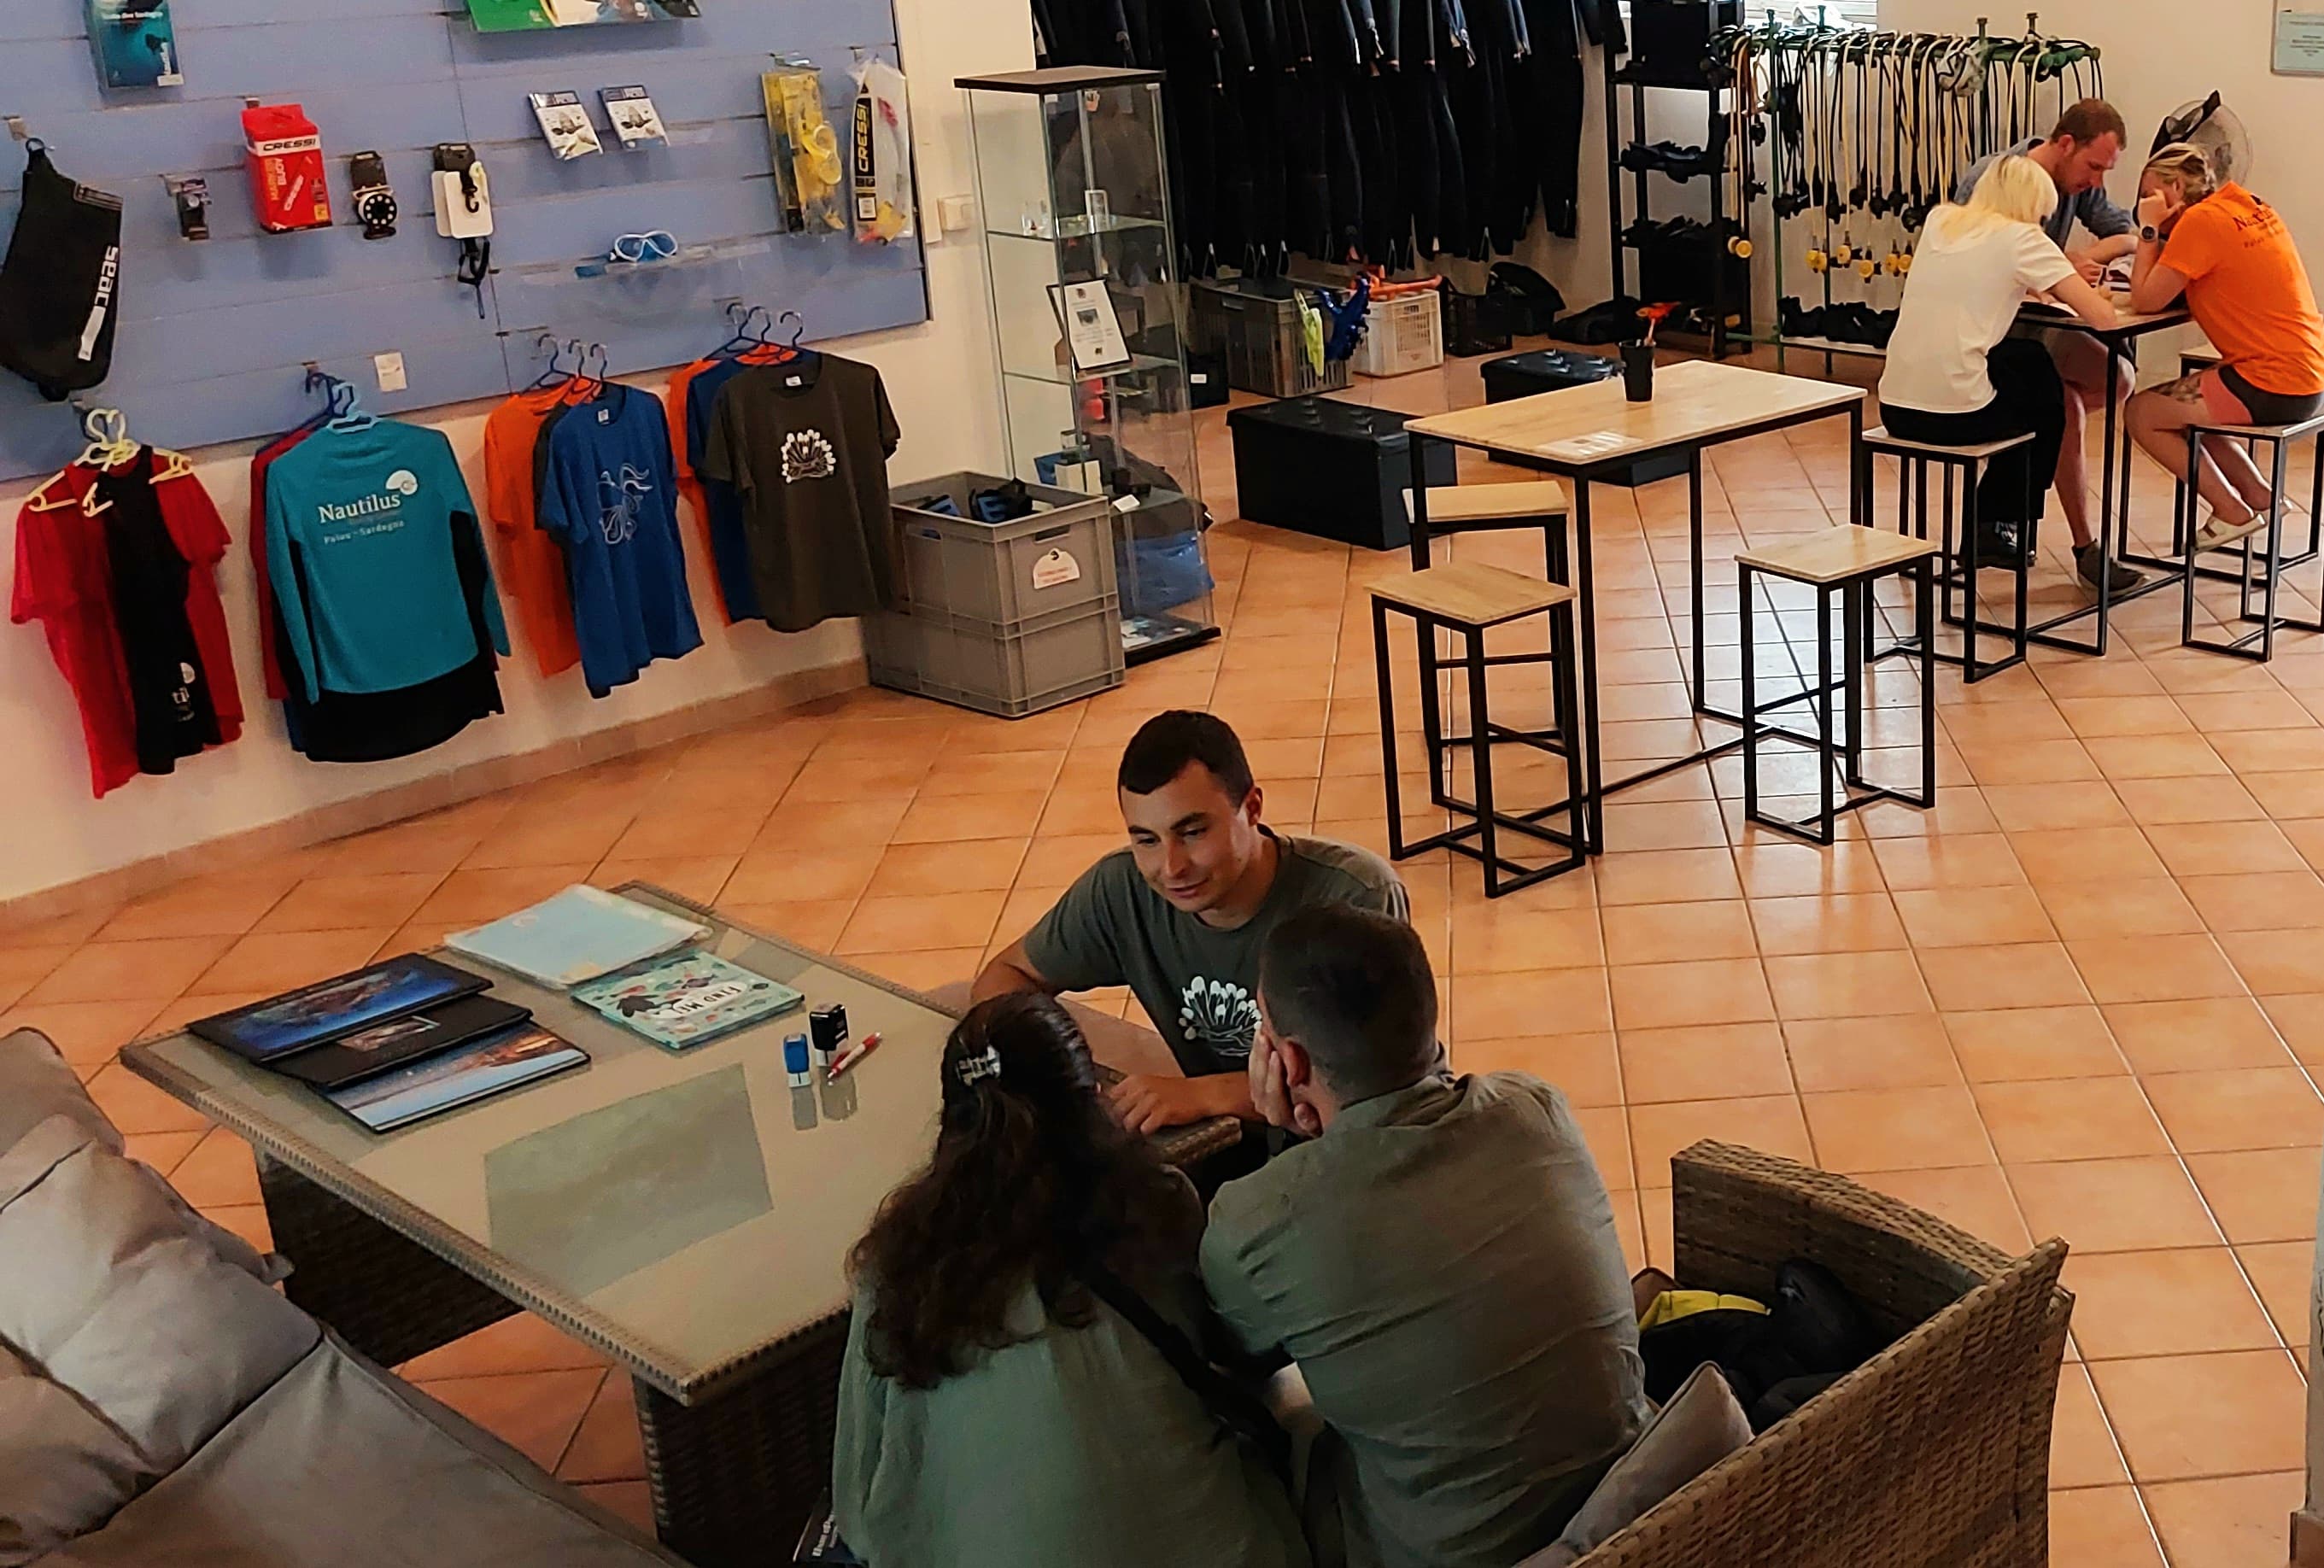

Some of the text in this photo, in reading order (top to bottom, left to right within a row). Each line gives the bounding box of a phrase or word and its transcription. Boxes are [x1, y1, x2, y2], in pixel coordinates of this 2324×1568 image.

[263, 138, 316, 152] CRESSI
[857, 103, 869, 173] CRESSI
[273, 157, 287, 185] BUOY
[317, 494, 401, 524] Nautilus
[703, 986, 742, 1003] FIND
